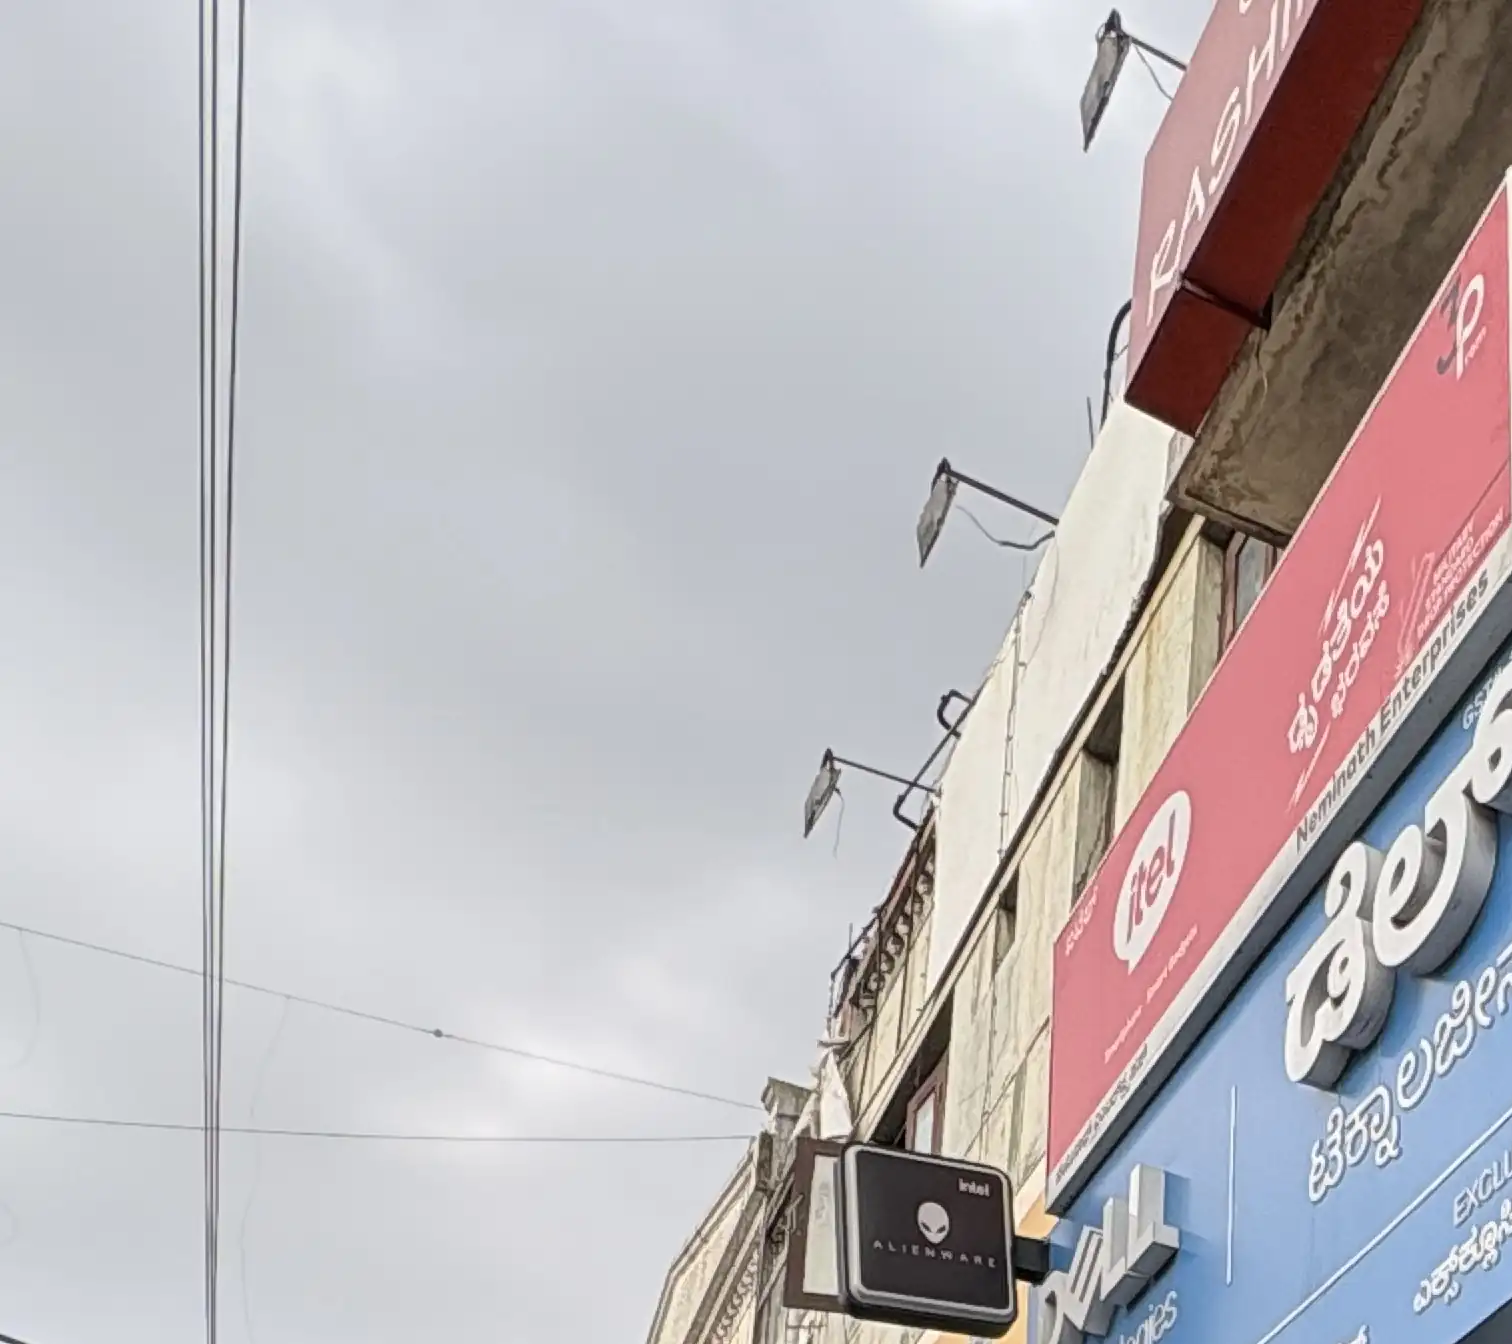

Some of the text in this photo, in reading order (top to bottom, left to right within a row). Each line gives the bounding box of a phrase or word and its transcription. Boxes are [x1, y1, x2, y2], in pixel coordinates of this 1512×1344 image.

[1146, 0, 1310, 327] RASHI
[1295, 568, 1489, 851] Neminath Enterprises
[1126, 808, 1176, 944] itel
[873, 1240, 996, 1268] ALIENWARE
